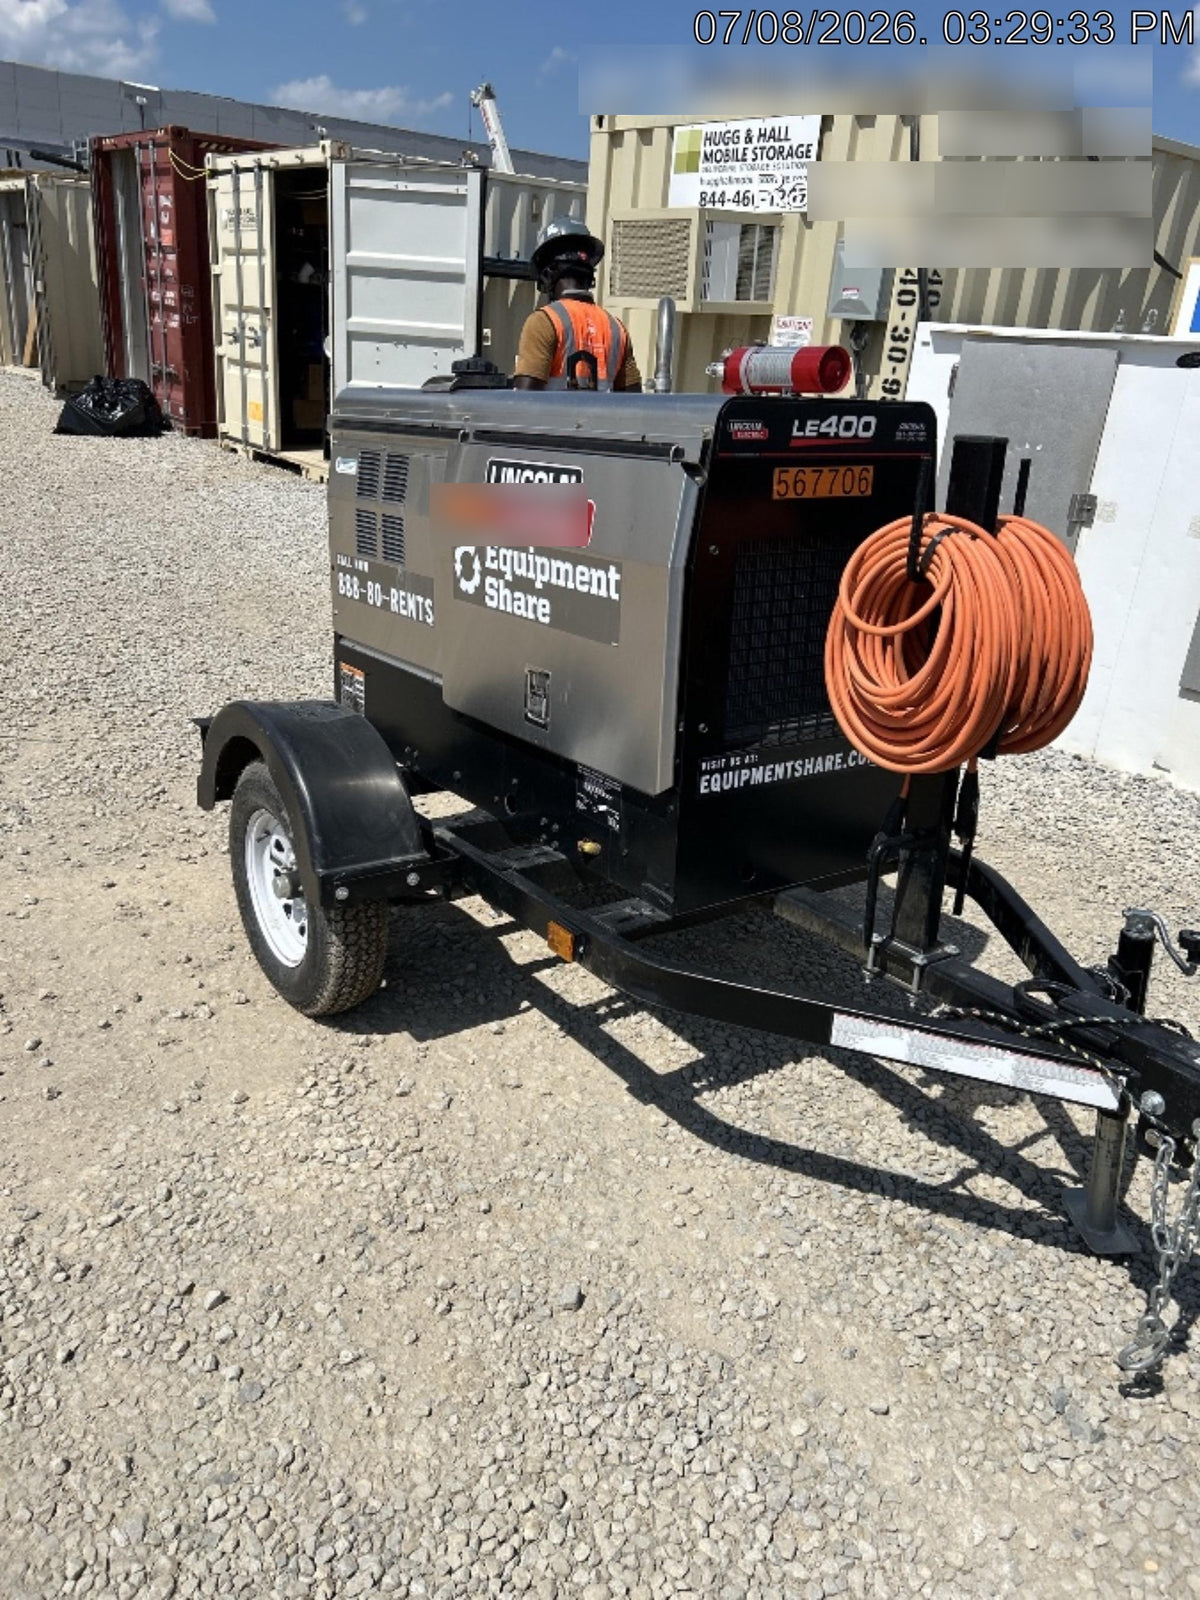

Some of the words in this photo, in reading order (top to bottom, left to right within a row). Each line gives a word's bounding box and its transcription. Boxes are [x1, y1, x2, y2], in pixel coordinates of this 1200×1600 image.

[702, 147, 749, 164] MOBILE
[751, 143, 812, 162] STORAGE
[703, 129, 741, 147] HUGG
[744, 127, 754, 145] &
[757, 125, 791, 143] HALL
[880, 268, 919, 401] 40-30-9
[791, 415, 878, 438] LE400
[777, 469, 872, 497] 567706
[485, 545, 621, 601] Equipment
[338, 571, 434, 625] 888-80-RENTS
[485, 576, 551, 624] Share
[701, 749, 872, 794] EQUIPMENTSHARE.CO
